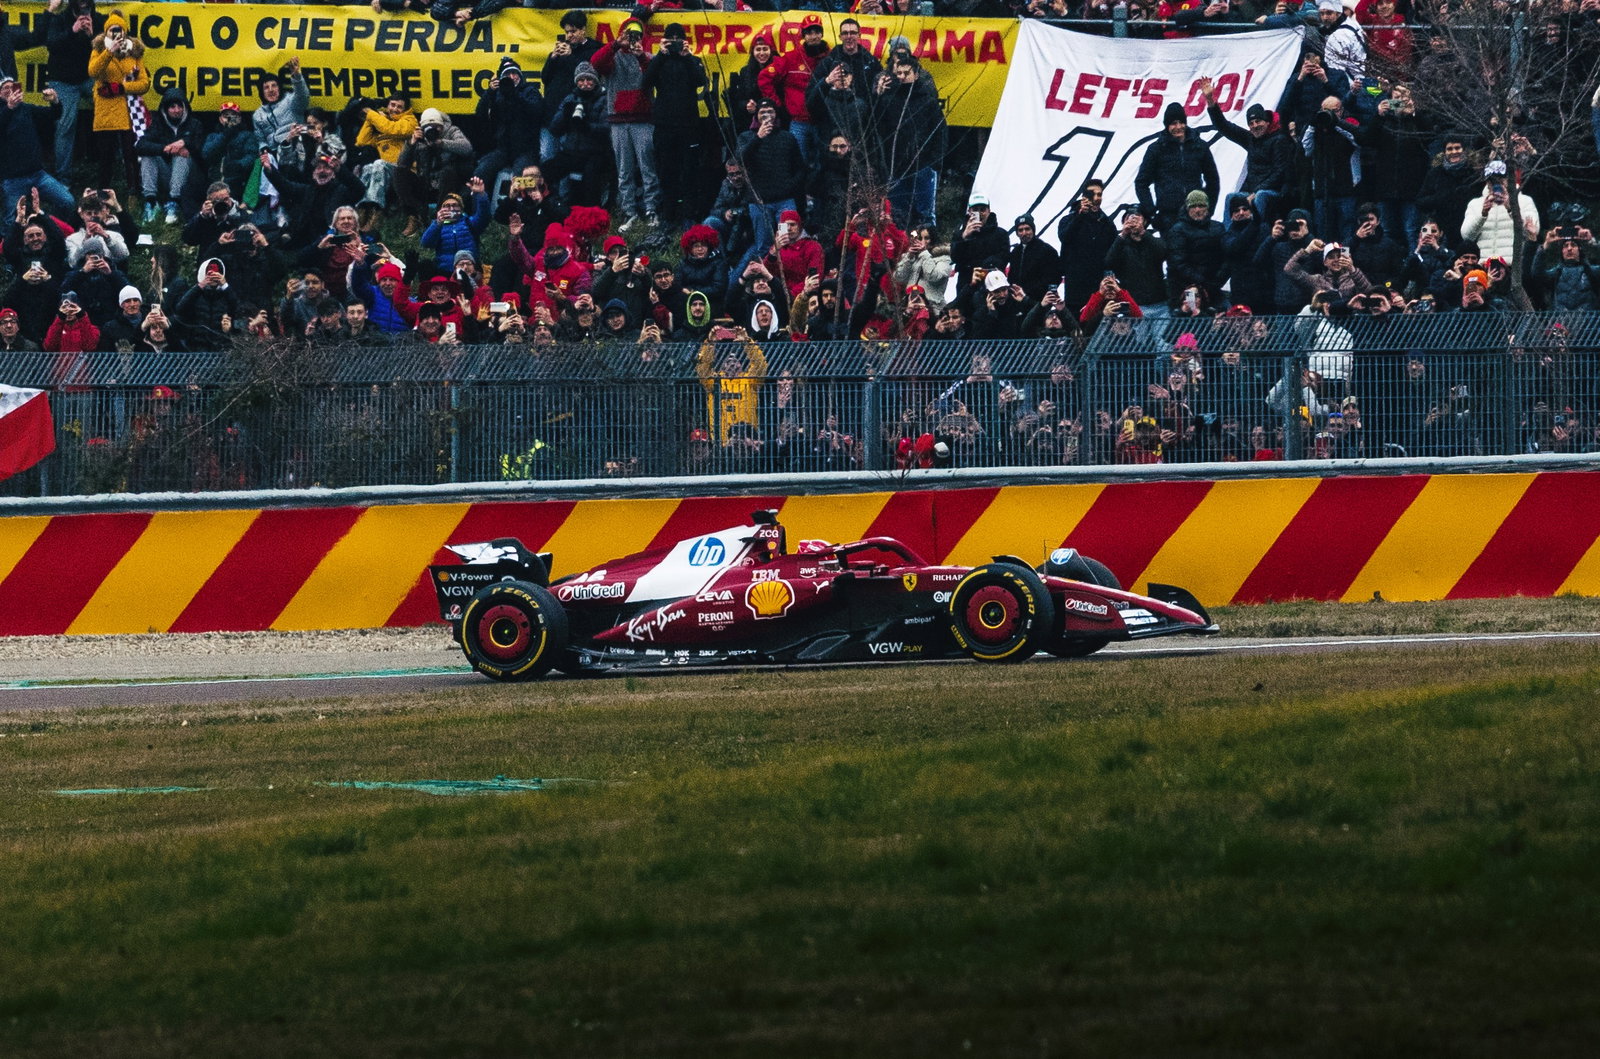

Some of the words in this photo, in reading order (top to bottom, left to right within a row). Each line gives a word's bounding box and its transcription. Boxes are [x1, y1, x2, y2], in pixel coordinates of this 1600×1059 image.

[210, 15, 239, 51] O
[255, 16, 334, 51] CHE
[344, 18, 520, 54] PERDA..
[912, 29, 1008, 65] AMA
[197, 66, 266, 97] PER
[278, 66, 423, 99] SEMPRE
[1045, 68, 1169, 118] LET'S
[1183, 68, 1255, 118] GO!
[689, 537, 726, 567] hp
[450, 573, 494, 581] V-Power
[751, 569, 781, 582] IBM
[800, 567, 817, 575] aws
[441, 586, 474, 597] VGW
[573, 582, 625, 599] UniCredit
[1074, 600, 1108, 615] UniCredit
[698, 611, 734, 623] PERONI
[609, 646, 635, 656] brembo
[868, 641, 904, 655] VGW
[903, 645, 923, 653] PLAY
